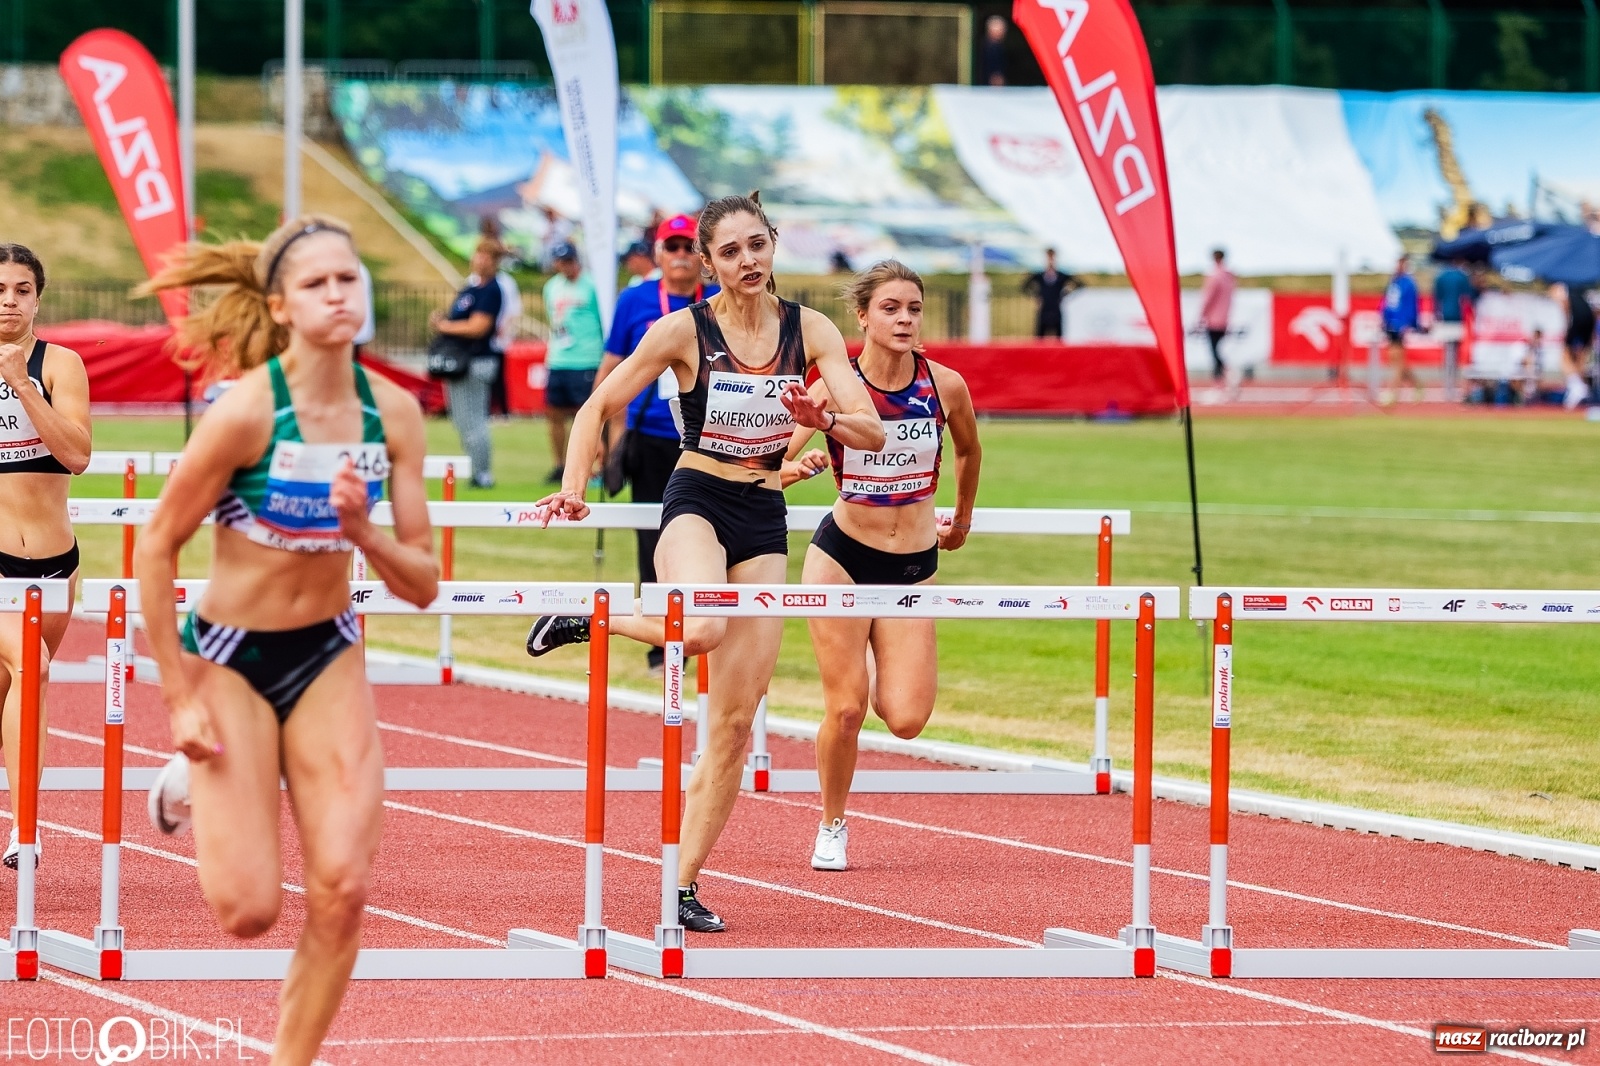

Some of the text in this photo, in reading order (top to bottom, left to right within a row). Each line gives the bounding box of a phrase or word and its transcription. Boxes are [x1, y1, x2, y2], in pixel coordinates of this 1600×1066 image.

[712, 382, 755, 394] 4MOVE
[896, 421, 933, 441] 364
[14, 448, 37, 459] 2019
[710, 441, 781, 456] RACIBÓRZ 2019
[863, 453, 917, 467] PLIZGA
[852, 481, 922, 493] RACIBÓRZ 2019
[350, 589, 374, 603] 4F
[451, 595, 485, 603] 4MOVE
[784, 595, 825, 606] ORLEN
[896, 594, 921, 608] 4F
[998, 600, 1031, 608] 4MOVE
[1331, 600, 1371, 610] ORLEN
[1442, 599, 1466, 612] 4F
[112, 661, 122, 708] polanik
[670, 664, 680, 710] polanik
[1218, 666, 1229, 712] polanik
